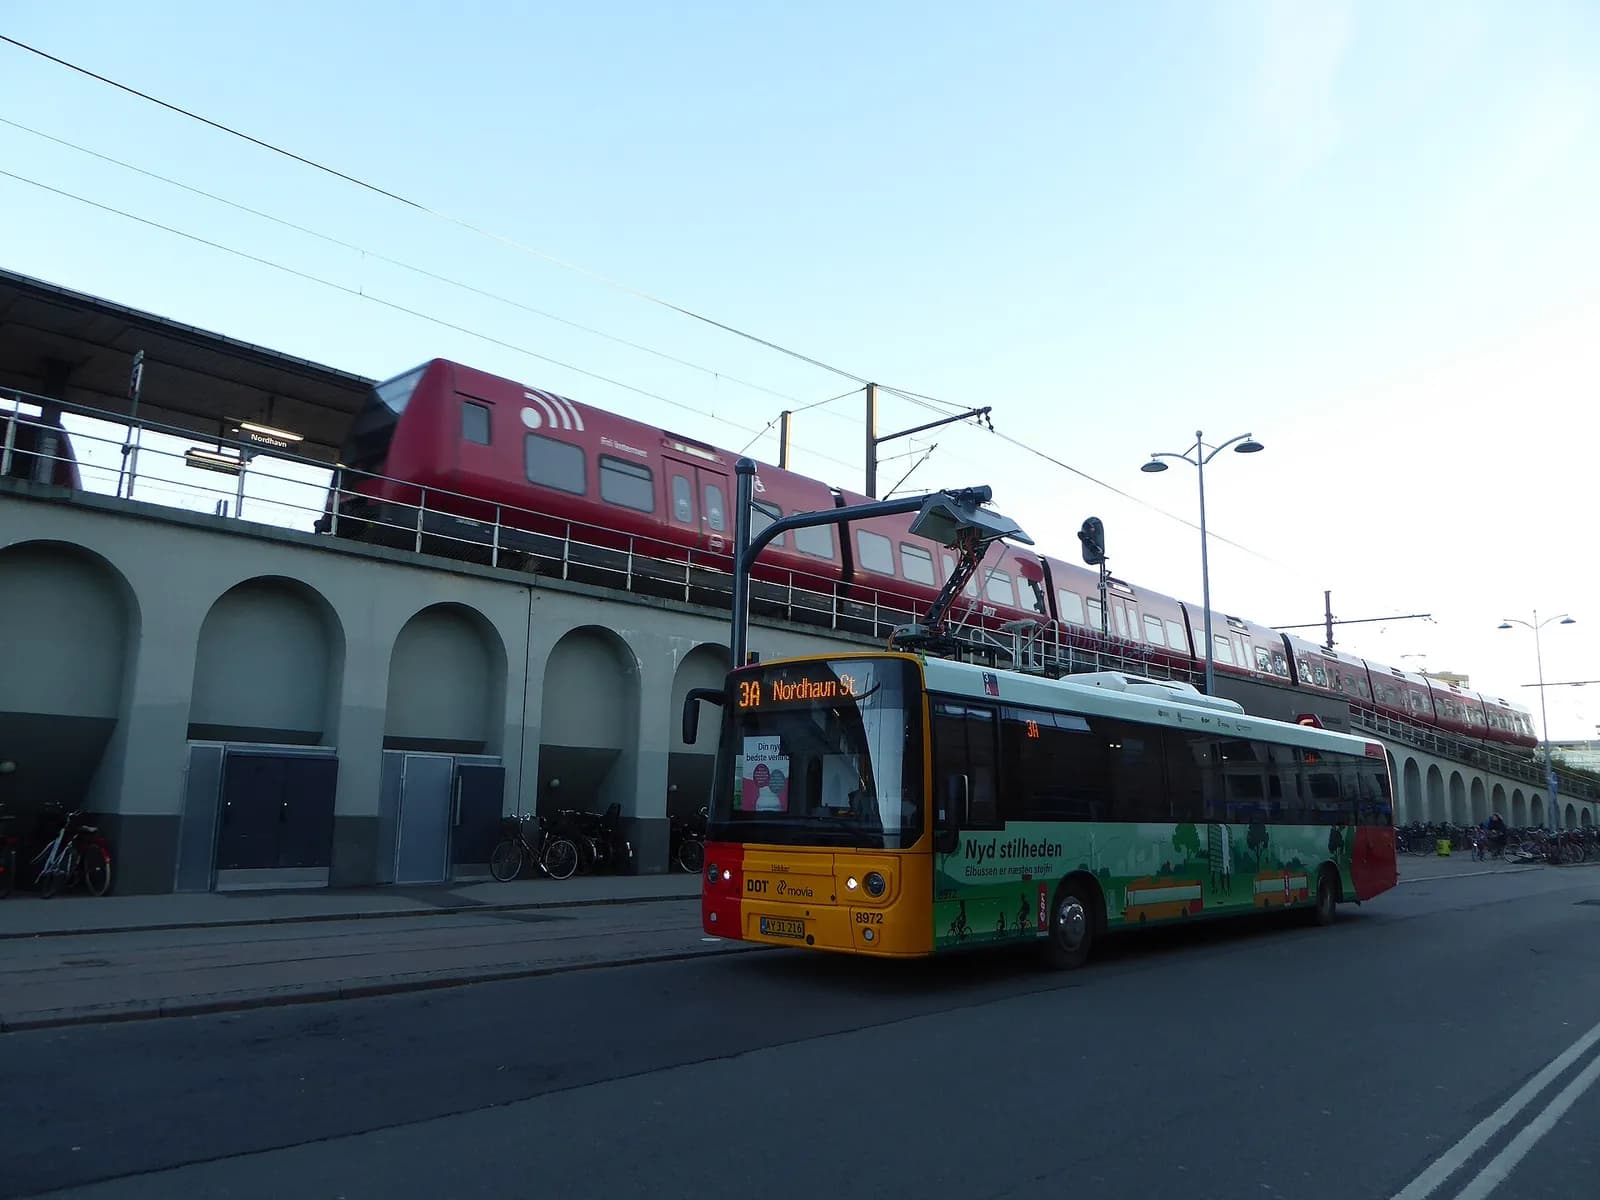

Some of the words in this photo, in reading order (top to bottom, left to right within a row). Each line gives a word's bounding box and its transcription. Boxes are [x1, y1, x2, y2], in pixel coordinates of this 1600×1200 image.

[250, 433, 287, 448] Nordhavn
[739, 681, 760, 708] 3A
[773, 678, 836, 701] Nordhavn
[1025, 720, 1040, 738] 3A
[965, 838, 996, 864] Nyd
[1000, 838, 1062, 859] stilheden
[965, 864, 998, 877] Elbussen
[1000, 867, 1007, 875] er
[747, 879, 769, 893] DOT
[788, 888, 813, 897] movia
[855, 912, 883, 924] 8972
